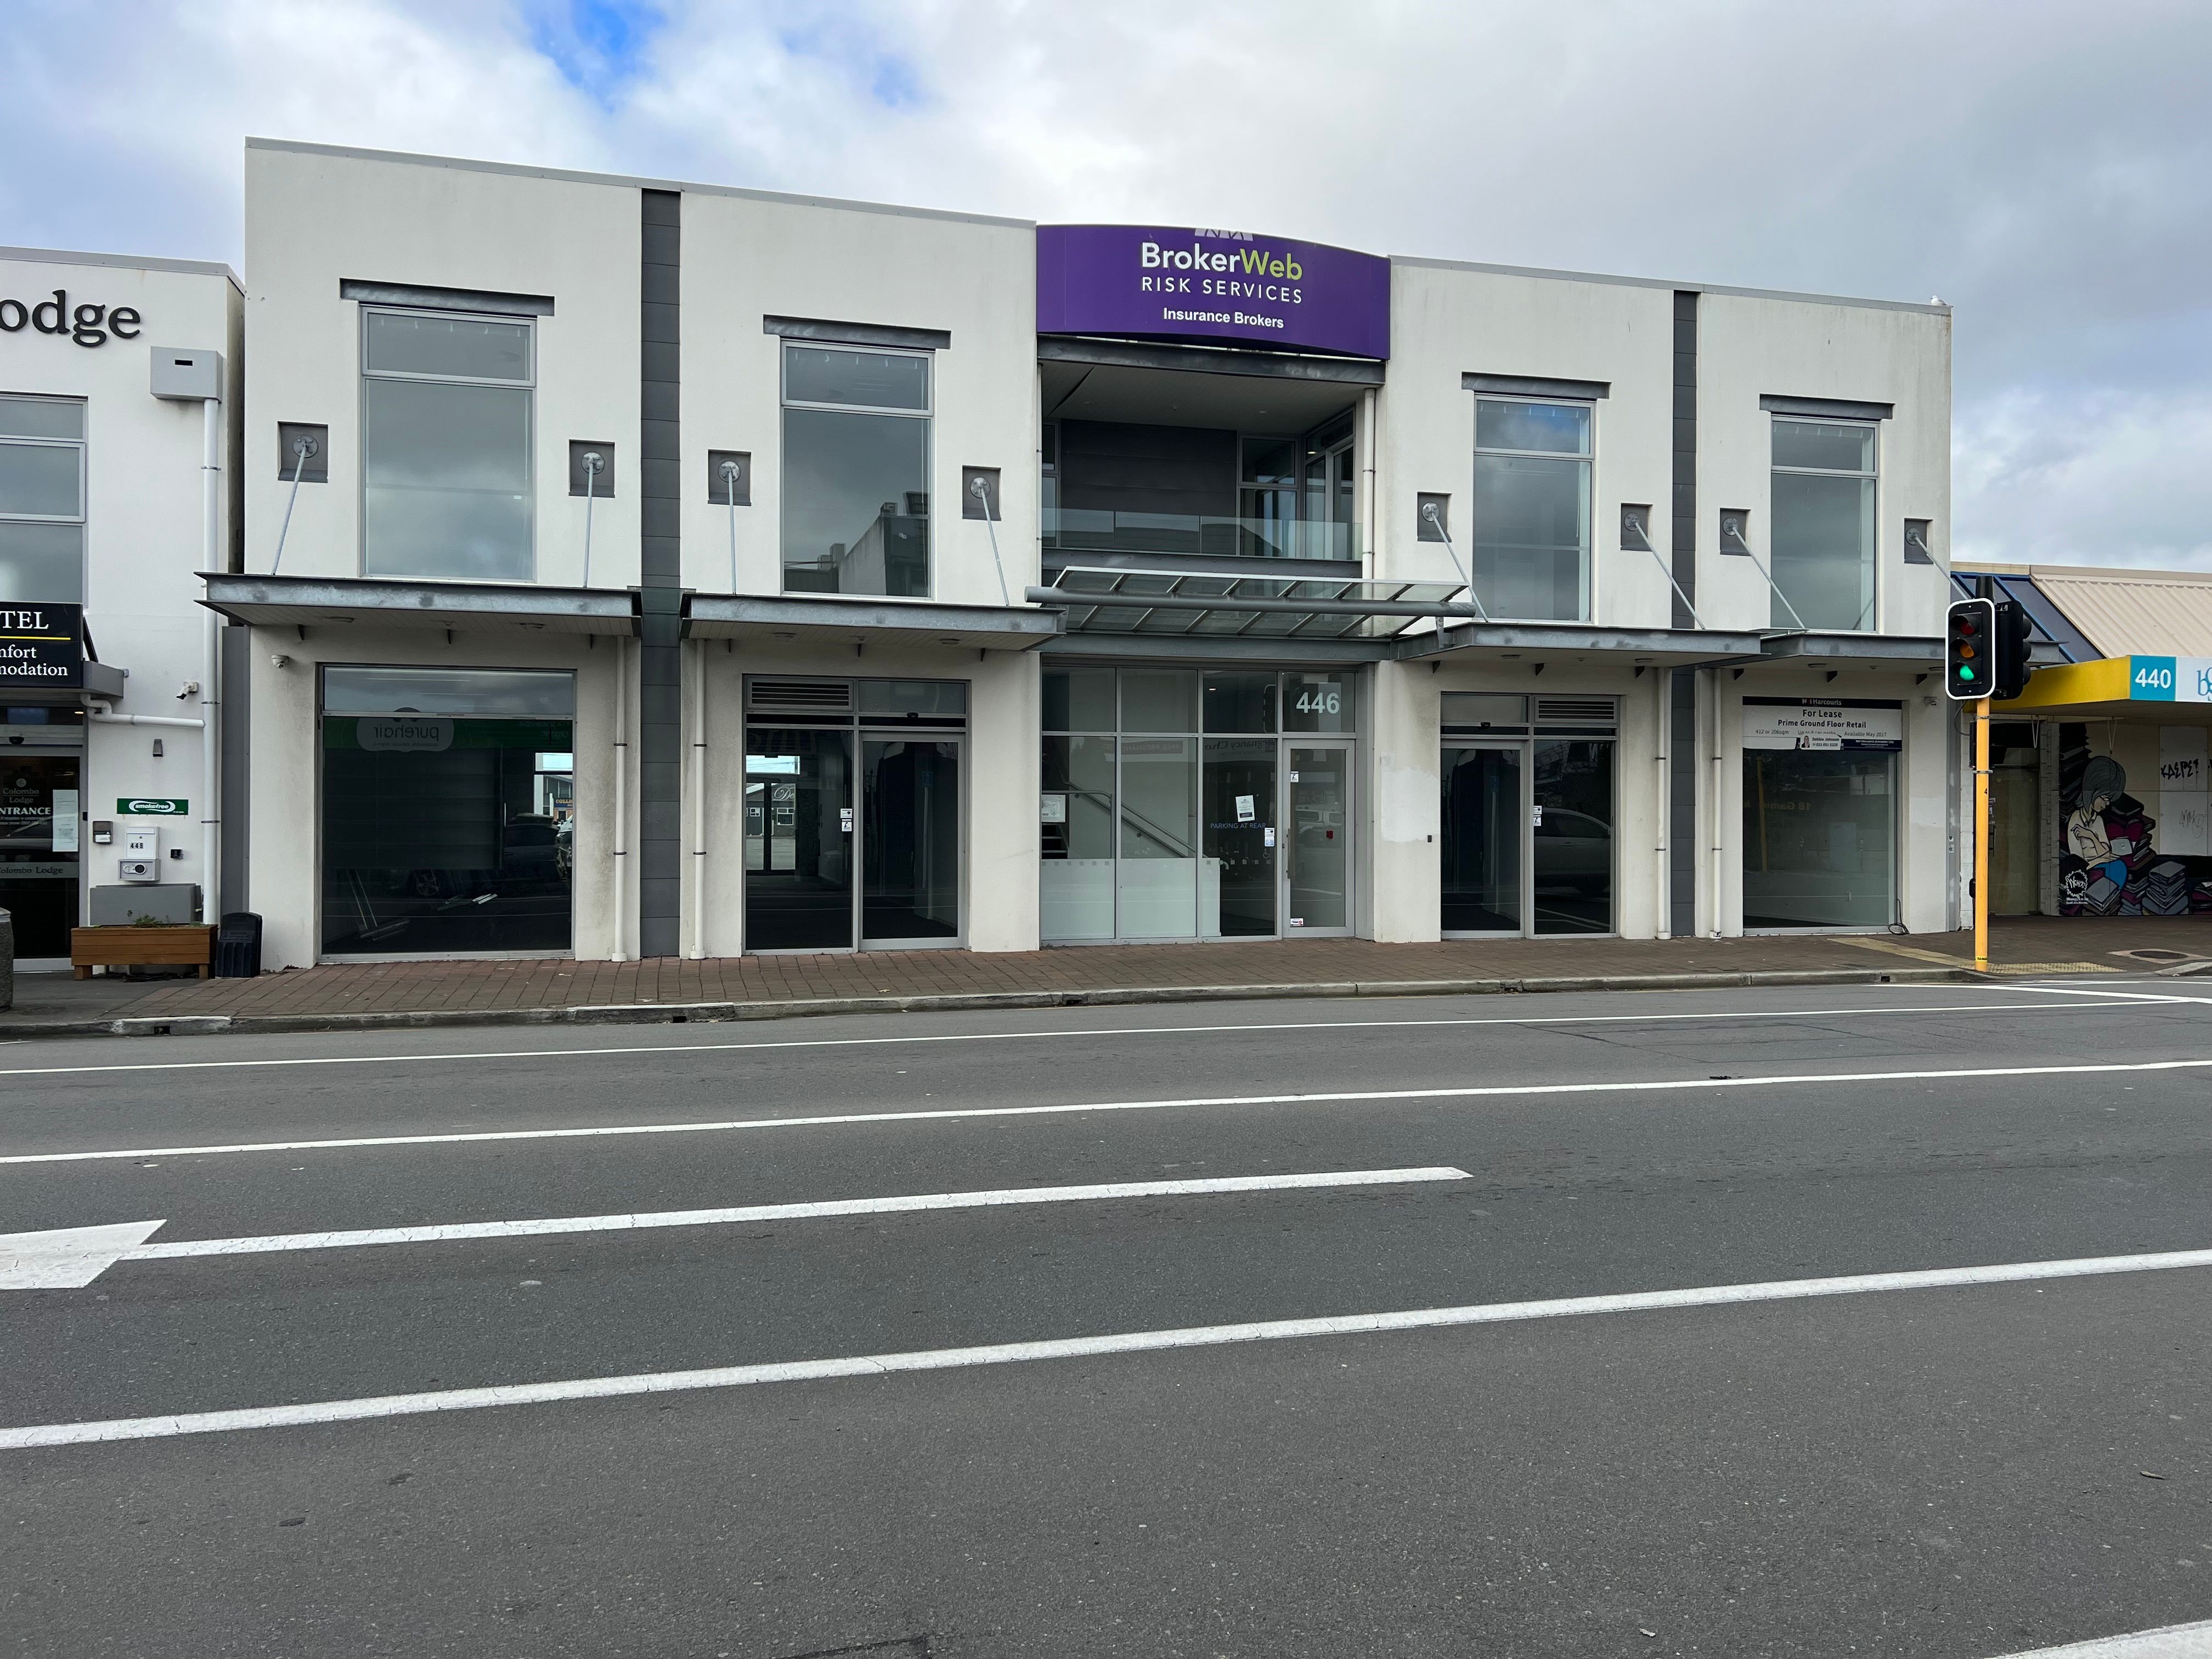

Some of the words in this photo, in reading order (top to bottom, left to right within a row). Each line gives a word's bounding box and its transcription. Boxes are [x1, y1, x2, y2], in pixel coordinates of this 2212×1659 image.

[1141, 241, 1303, 280] BrokerWeb
[1142, 276, 1191, 294] RISK
[1202, 279, 1302, 304] SERVICES
[1163, 307, 1231, 324] Insurance
[1234, 311, 1284, 329] Brokers
[2135, 668, 2171, 689] 440
[1296, 692, 1340, 714] 446
[1819, 709, 1843, 718] Lease
[36, 866, 64, 875] Lodge
